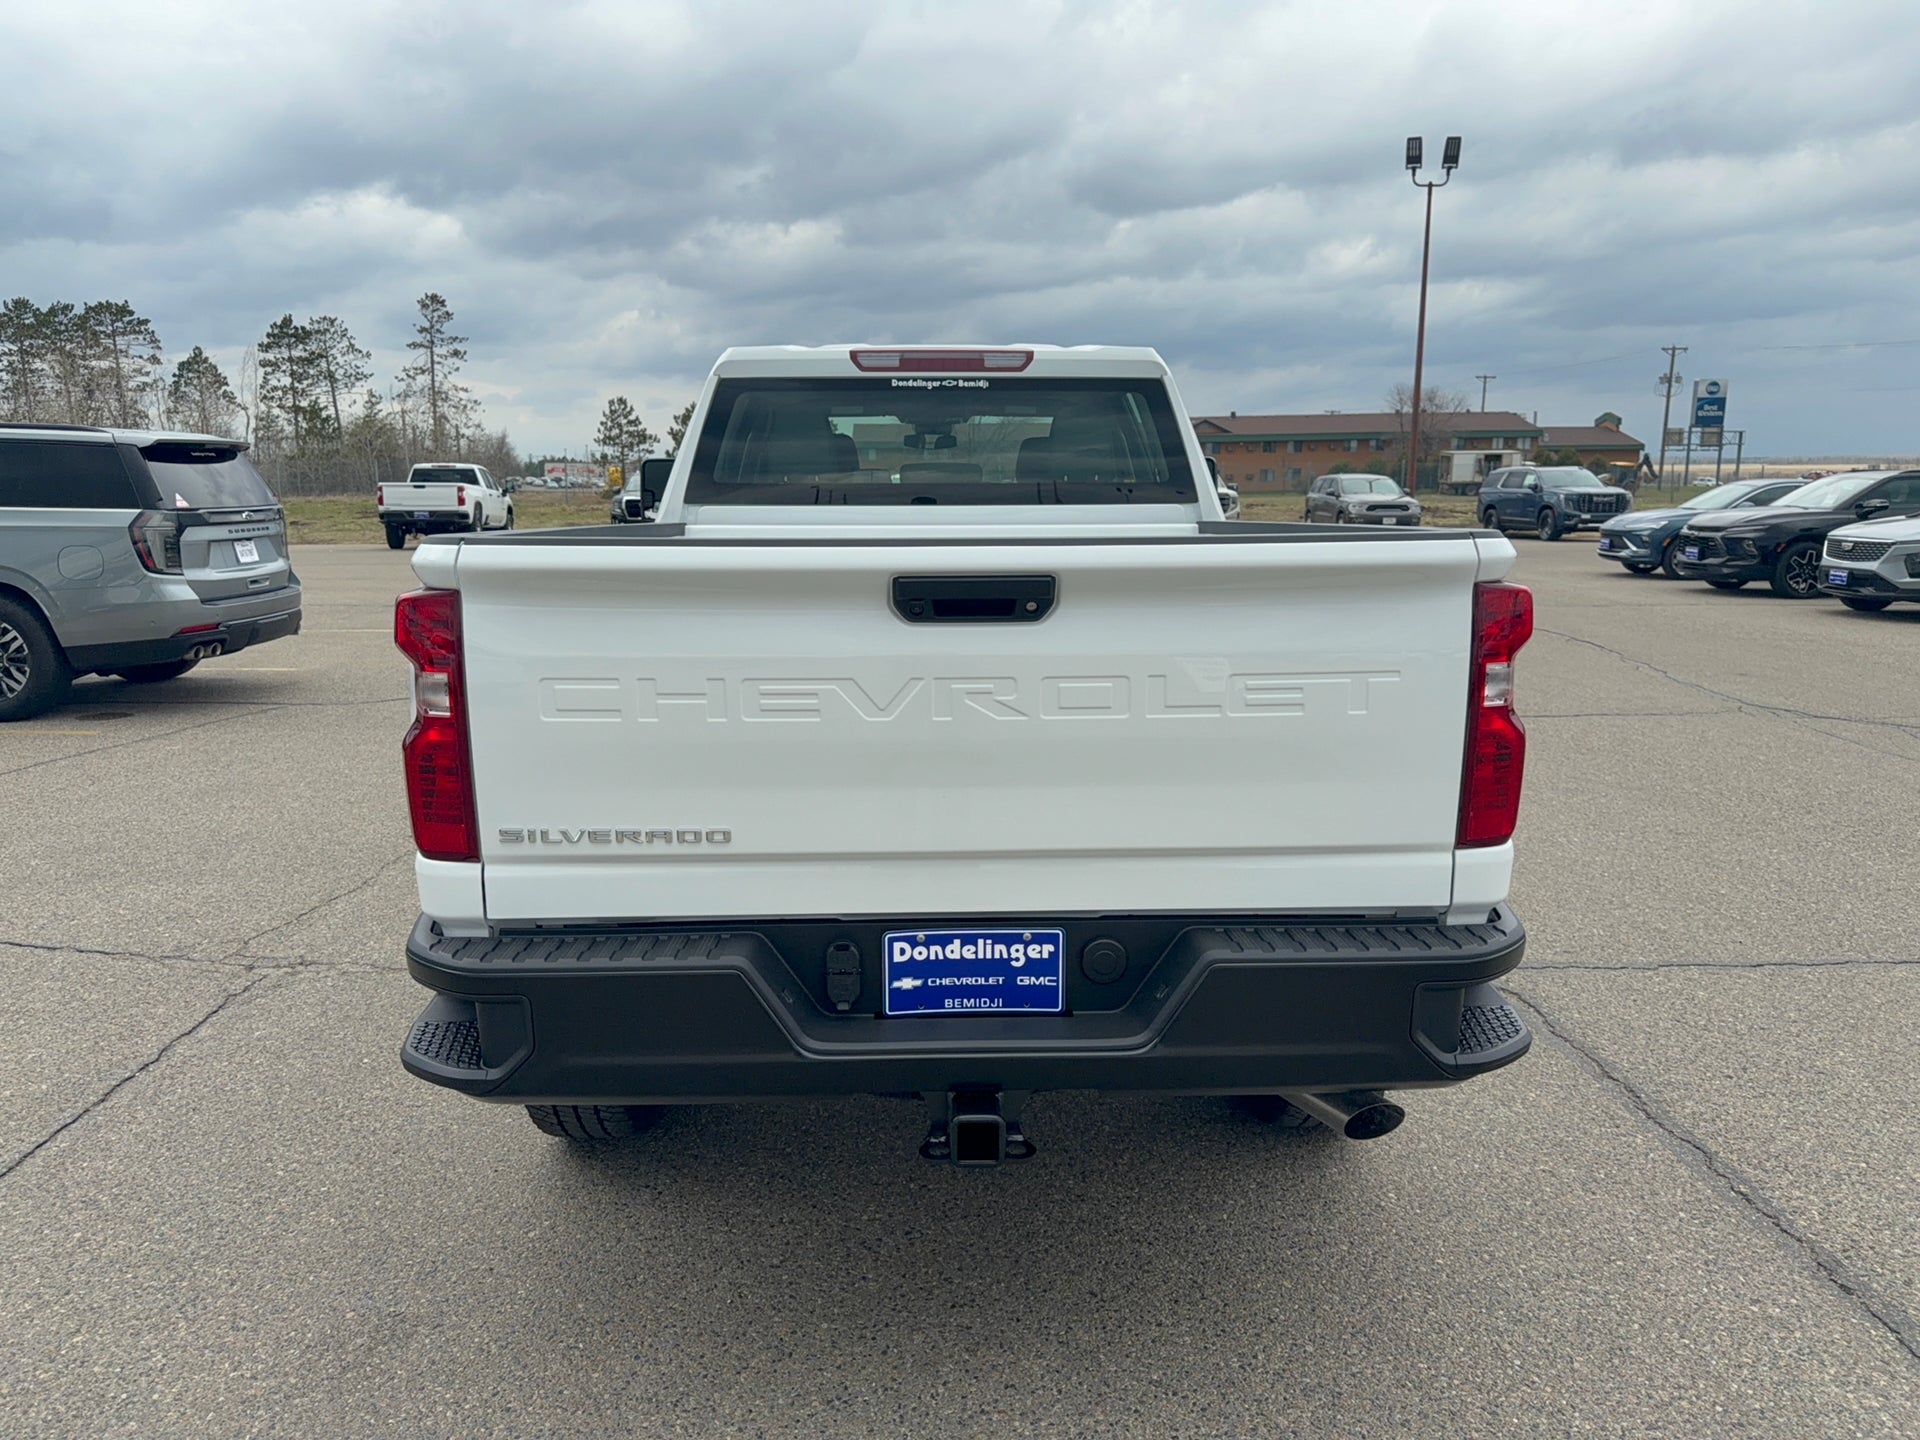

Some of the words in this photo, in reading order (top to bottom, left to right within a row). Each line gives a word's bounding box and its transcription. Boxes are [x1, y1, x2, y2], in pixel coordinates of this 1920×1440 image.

[891, 378, 941, 390] Dondelinger
[958, 379, 989, 390] Bemidji
[538, 669, 1401, 722] CHEVROLET
[498, 828, 732, 844] SILVERADO
[893, 938, 1055, 967] Dondelinger
[927, 976, 1005, 986] CHEVROLET
[1016, 976, 1057, 986] GMC
[944, 998, 1003, 1009] BEMIDJI
